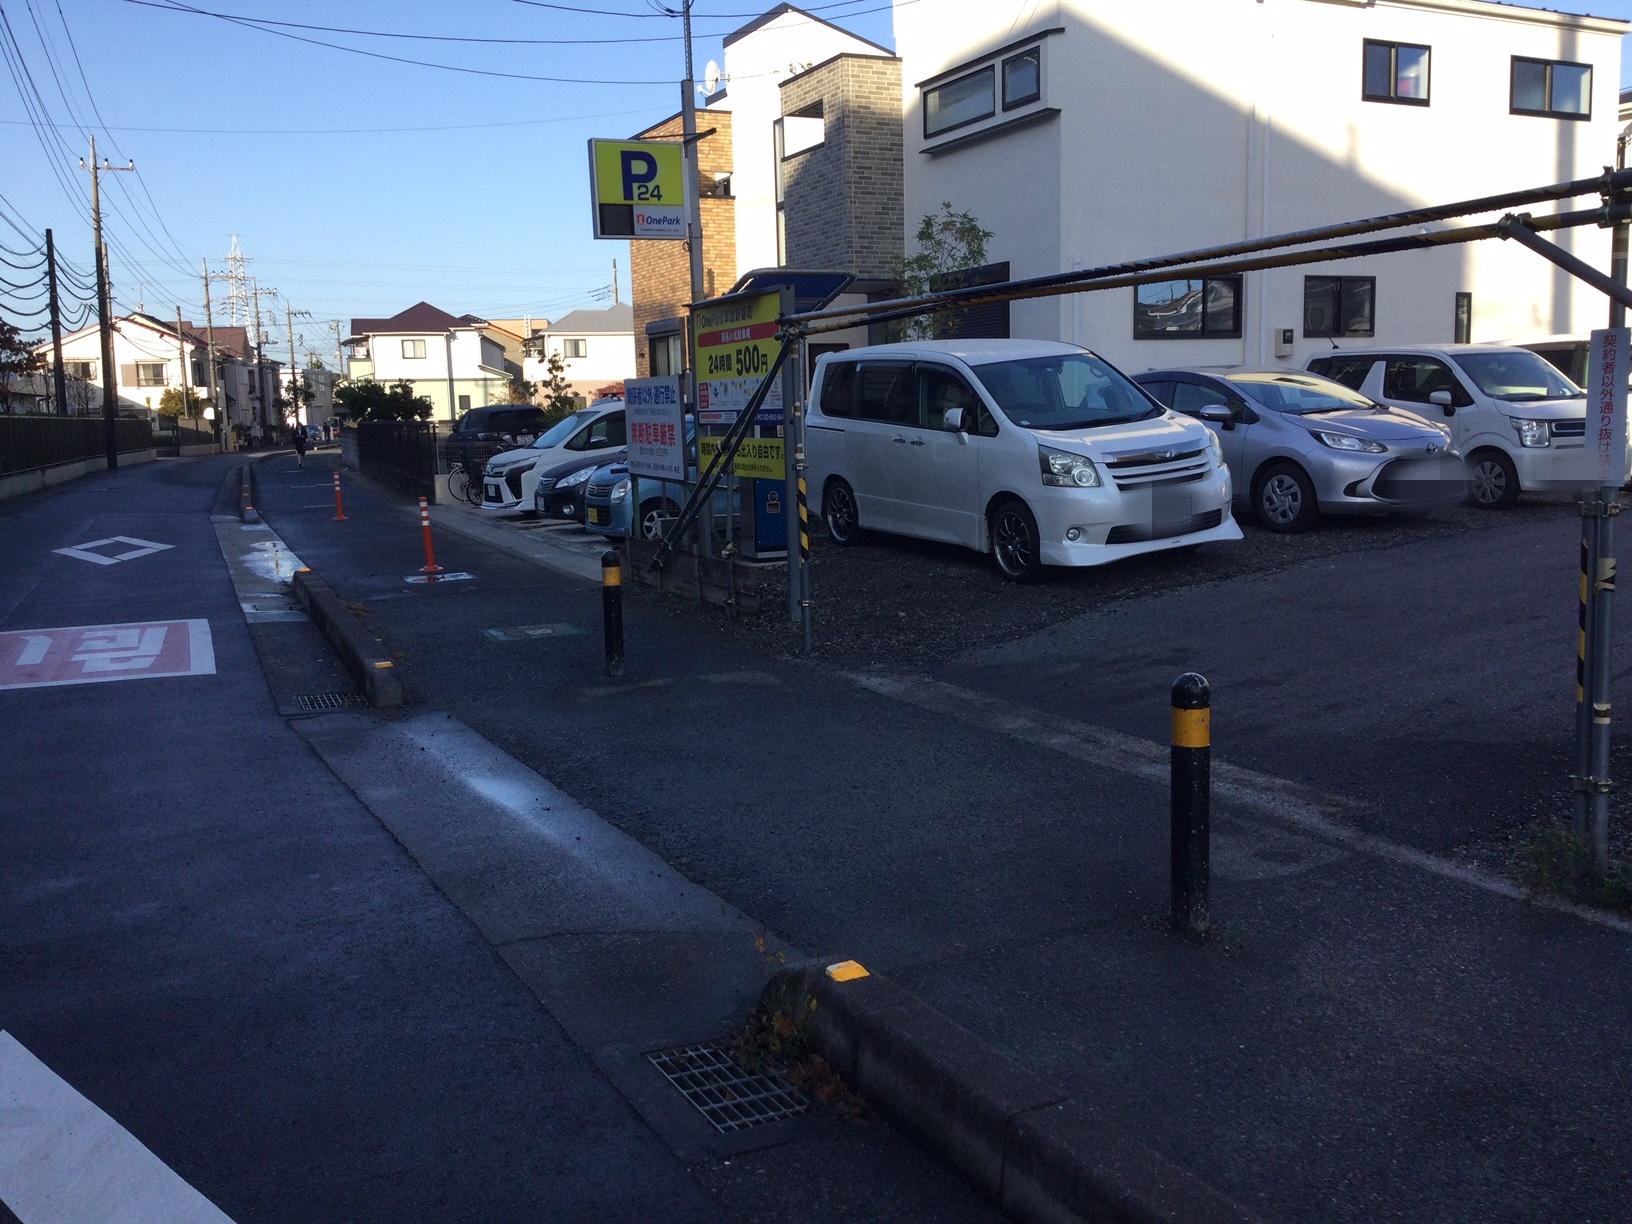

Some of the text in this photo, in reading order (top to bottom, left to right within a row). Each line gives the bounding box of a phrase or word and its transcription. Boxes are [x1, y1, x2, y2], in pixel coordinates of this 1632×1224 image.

[620, 150, 658, 201] P
[637, 184, 663, 202] 24
[646, 215, 681, 226] OnePark
[708, 344, 768, 376] 24時間 500円
[1598, 334, 1617, 480] 契約者以外通り抜け
